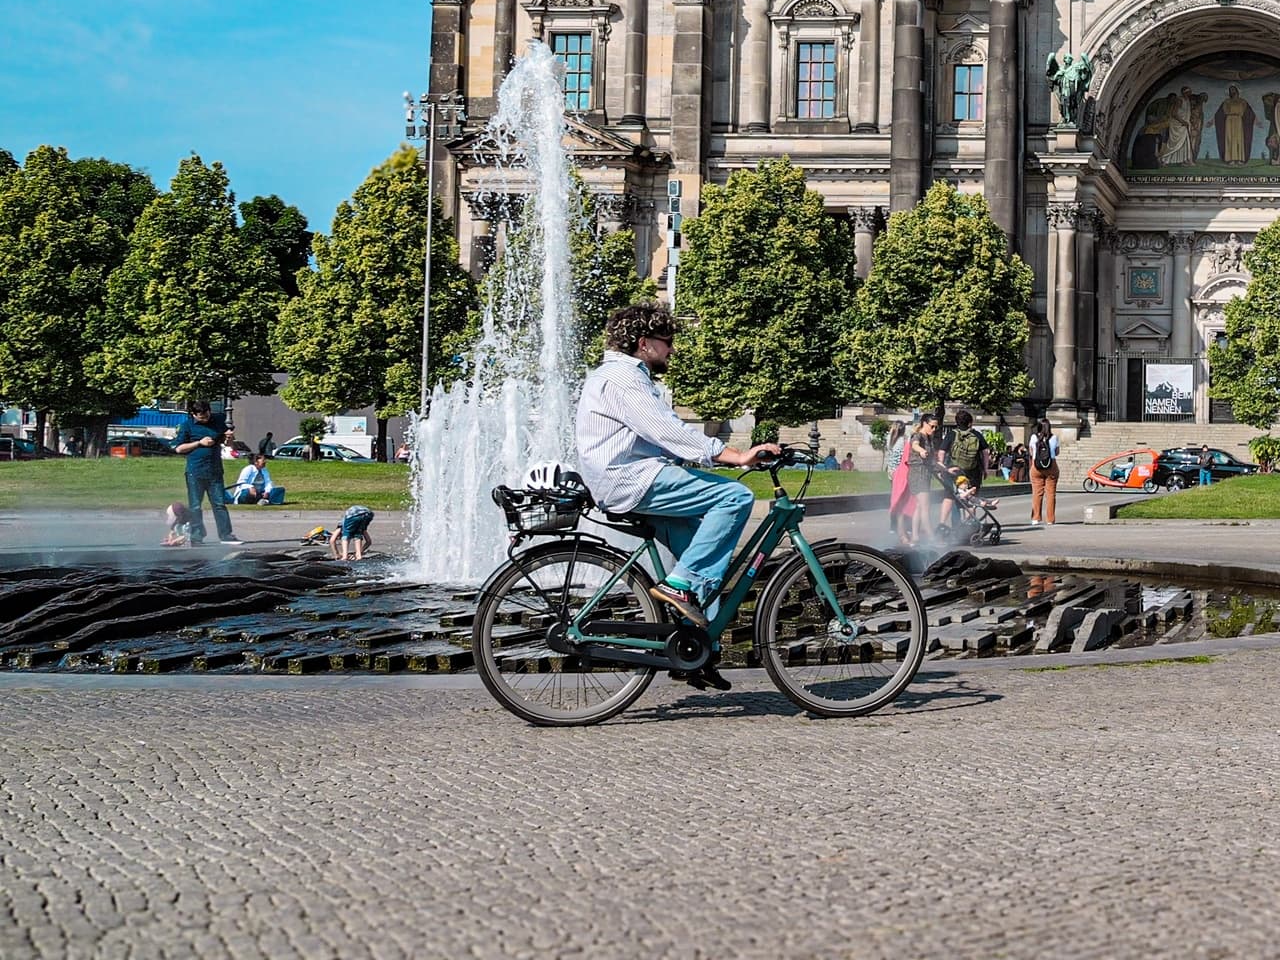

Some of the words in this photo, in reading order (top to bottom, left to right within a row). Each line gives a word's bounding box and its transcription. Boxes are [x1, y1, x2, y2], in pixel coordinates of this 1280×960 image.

[1172, 391, 1193, 399] BEIM
[1145, 399, 1177, 407] NAMEN
[1145, 406, 1182, 414] NENNEN
